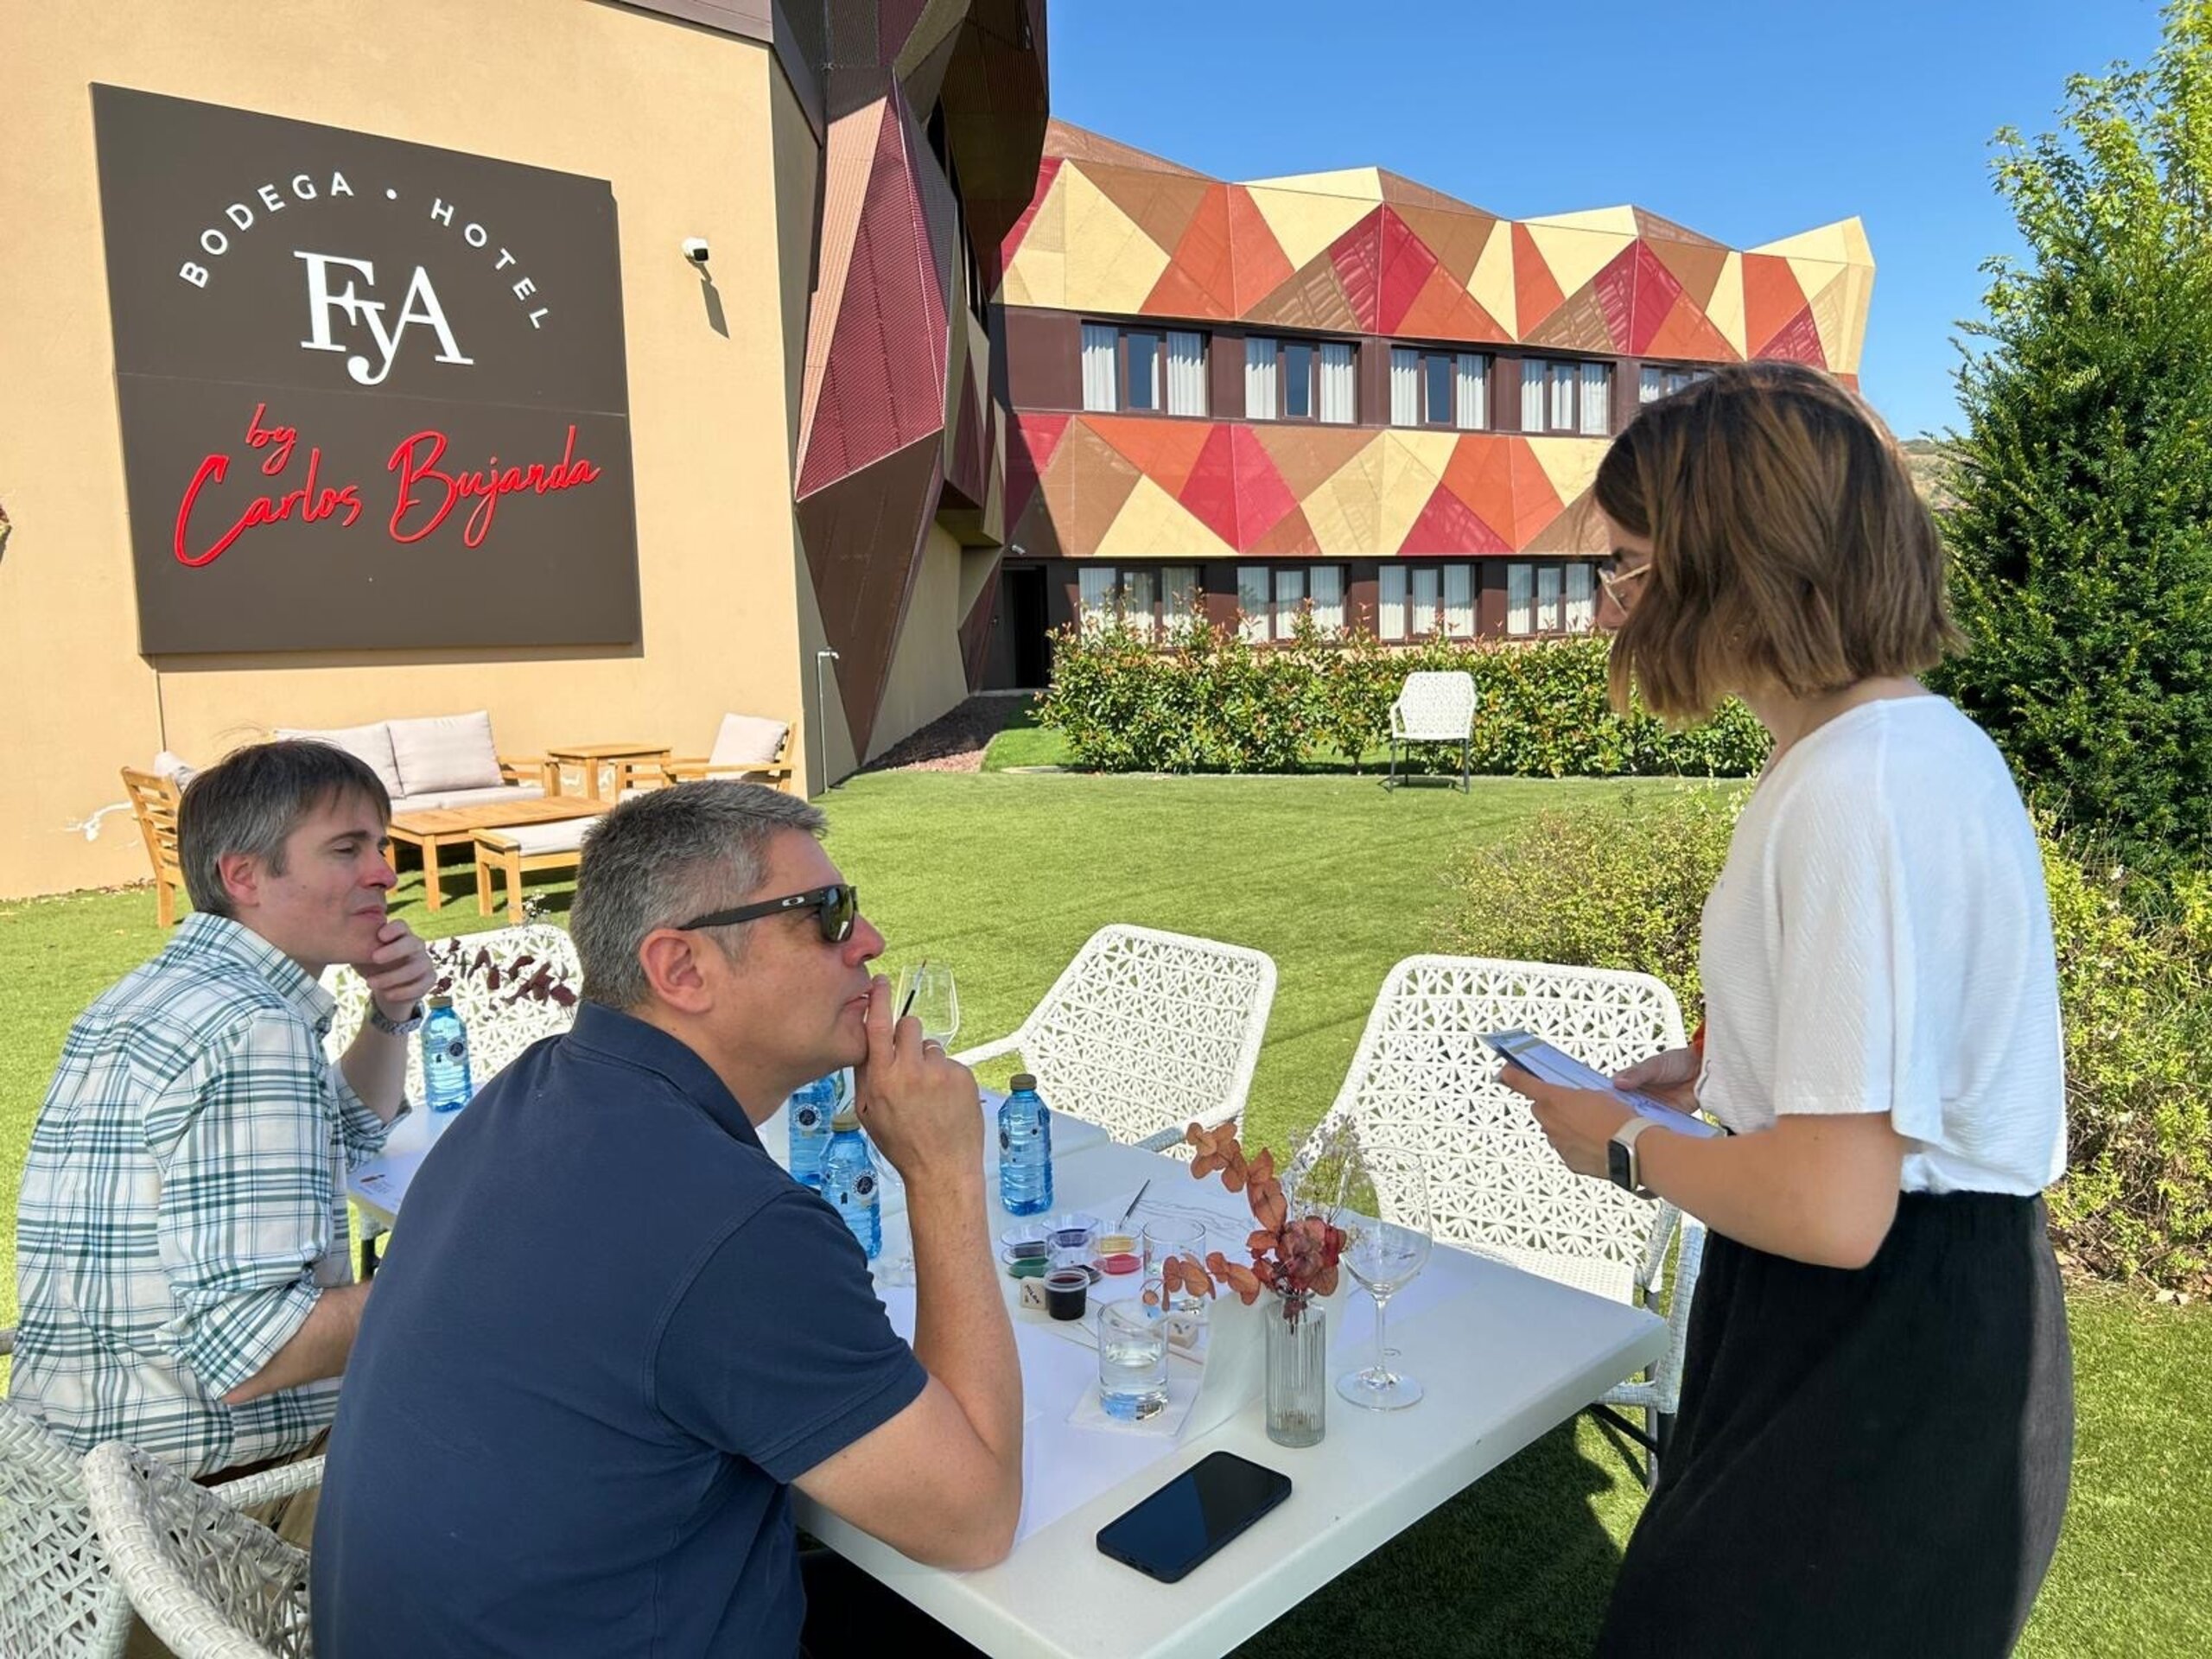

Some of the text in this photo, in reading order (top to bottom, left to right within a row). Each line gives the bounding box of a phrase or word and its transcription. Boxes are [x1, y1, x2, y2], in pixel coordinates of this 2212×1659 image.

[178, 171, 551, 329] BODEGA HOTEL
[173, 424, 601, 569] Carlos Bujanda
[245, 403, 298, 477] by
